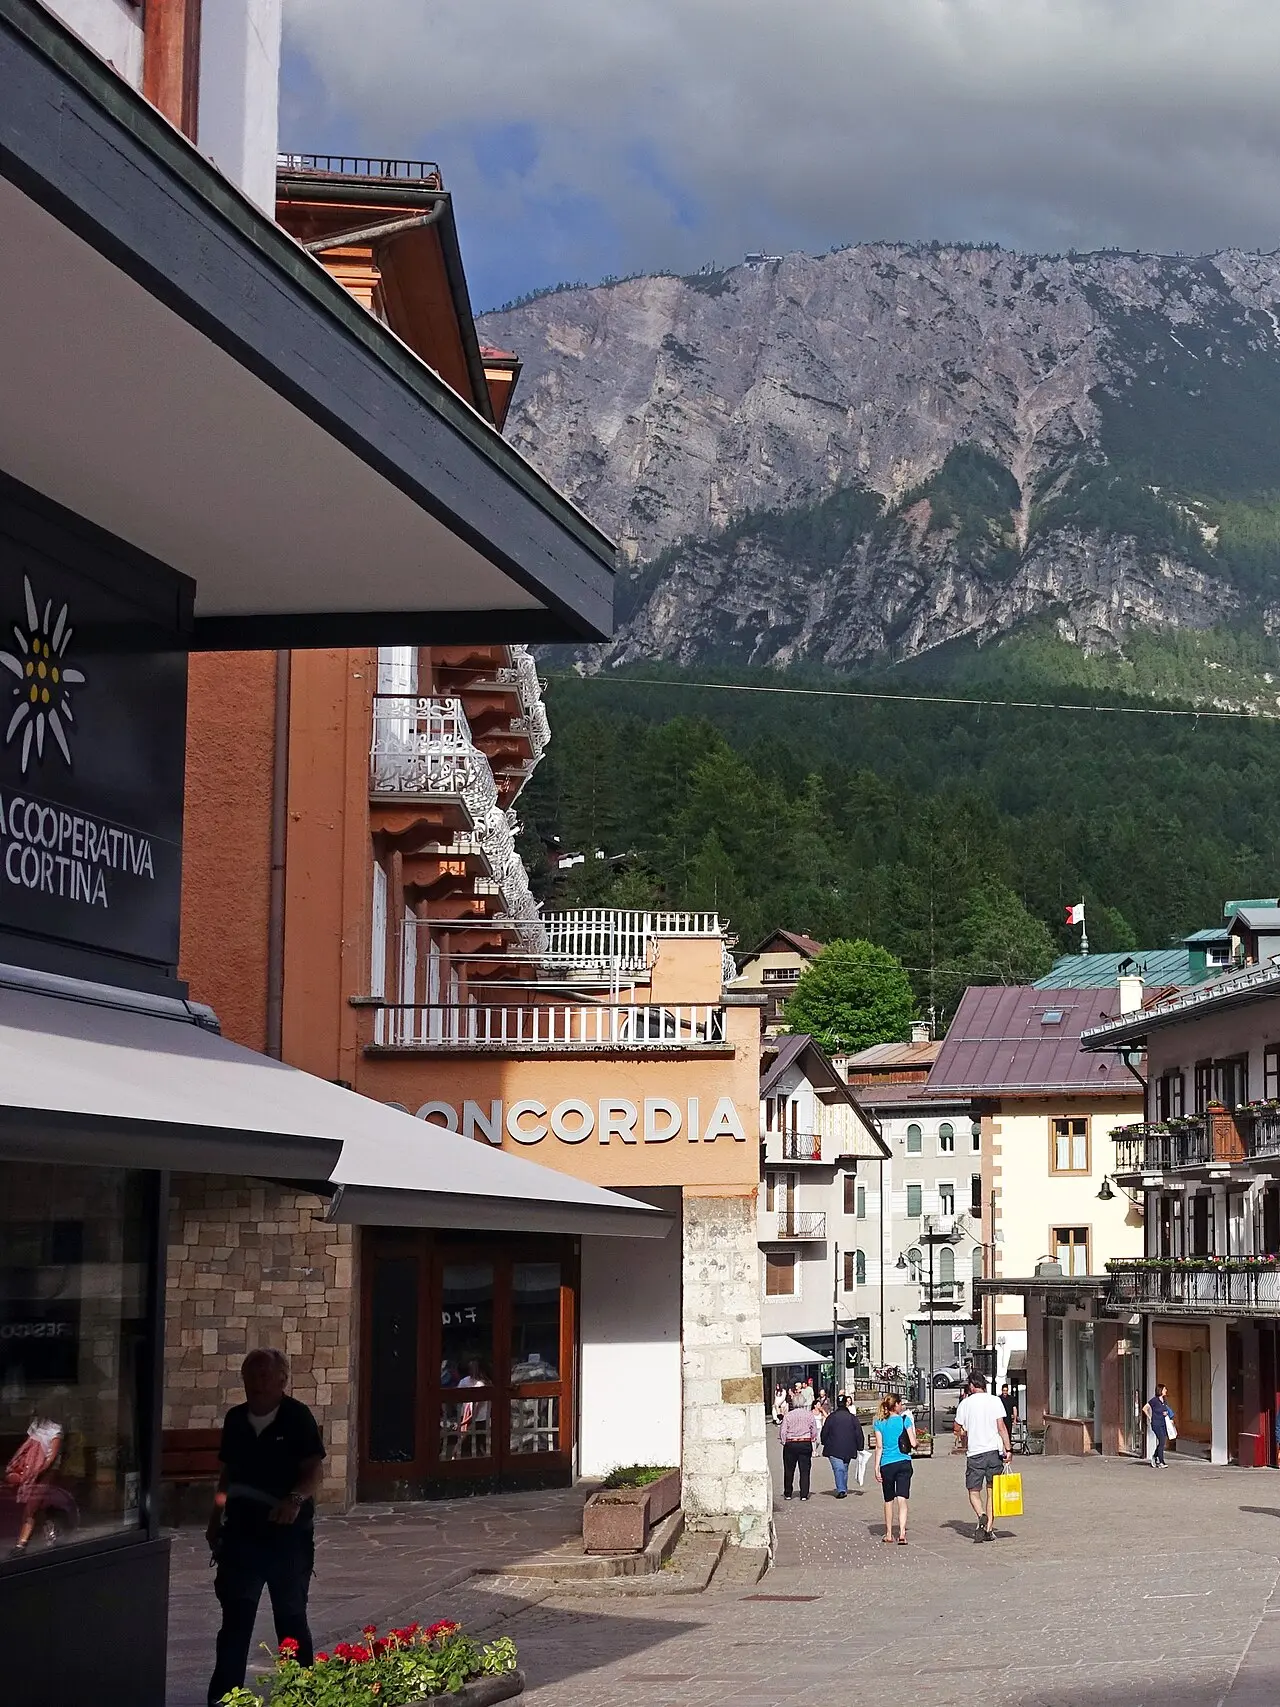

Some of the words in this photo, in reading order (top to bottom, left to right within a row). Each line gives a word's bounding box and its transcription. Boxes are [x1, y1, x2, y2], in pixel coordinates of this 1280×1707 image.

[9, 796, 155, 880] COOPERATIVA
[5, 841, 109, 909] CORTINA
[383, 1097, 746, 1144] ONCORDIA
